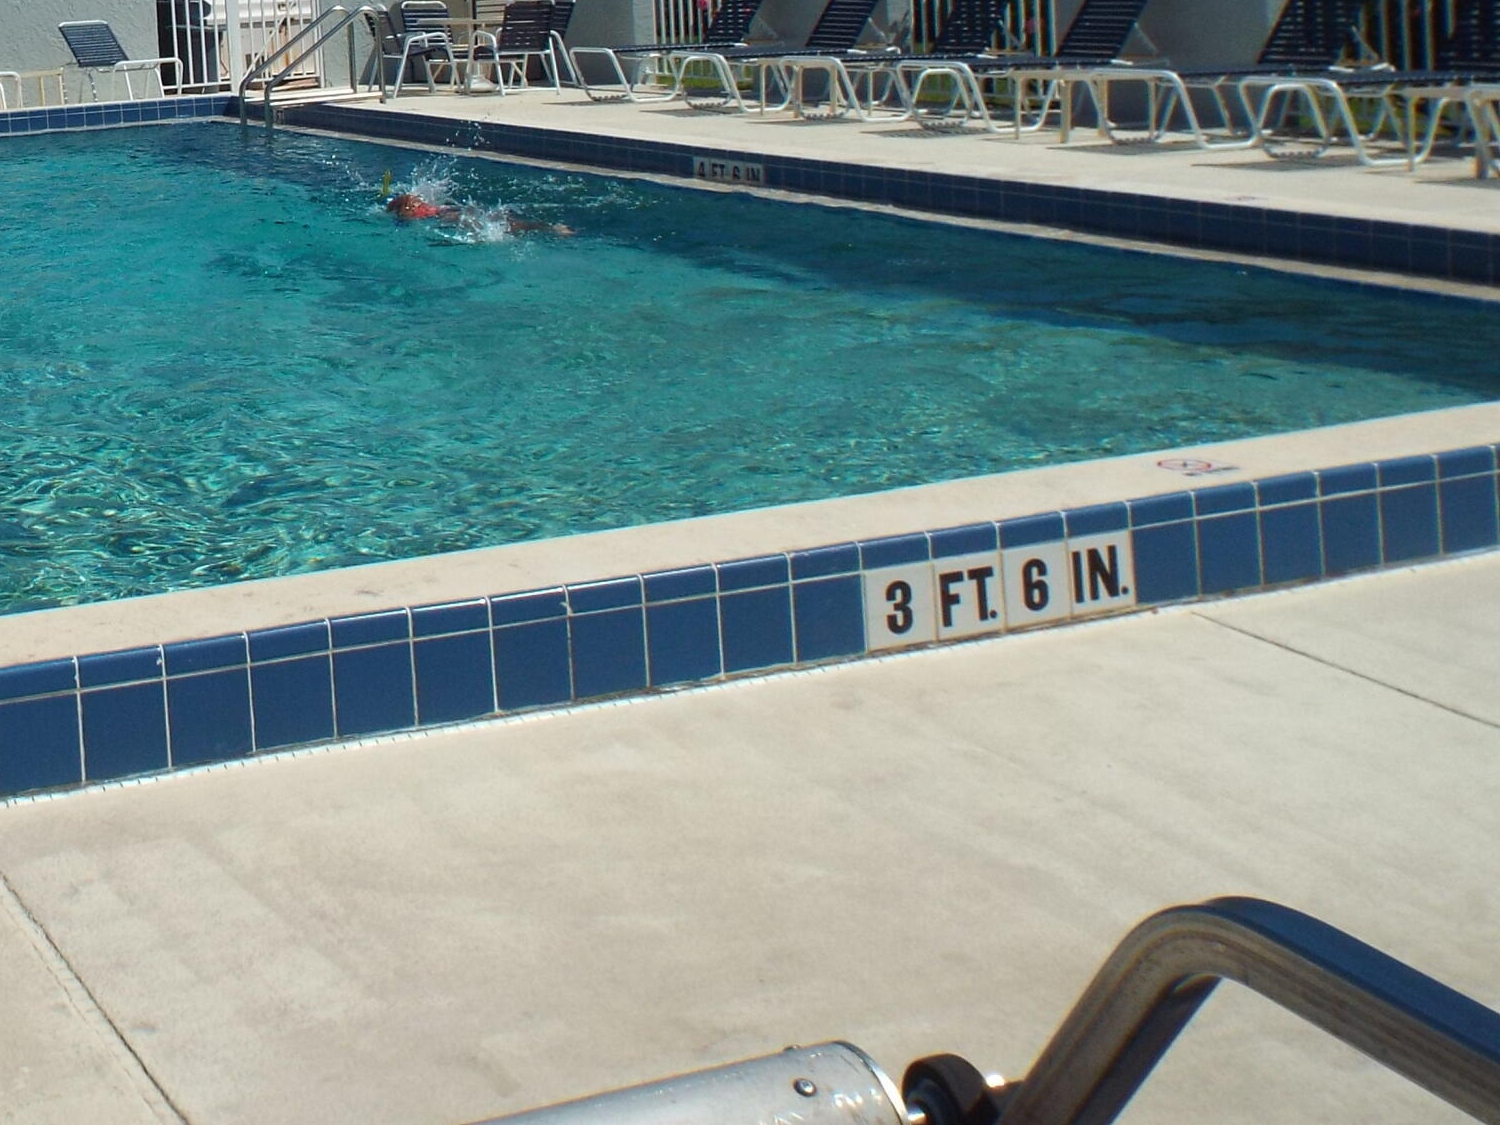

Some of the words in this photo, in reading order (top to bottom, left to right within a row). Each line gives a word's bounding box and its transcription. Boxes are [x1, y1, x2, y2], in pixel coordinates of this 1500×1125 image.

[885, 579, 914, 635] 3
[938, 565, 998, 628] FT.
[1021, 558, 1049, 612] 6
[1071, 544, 1130, 604] IN.
